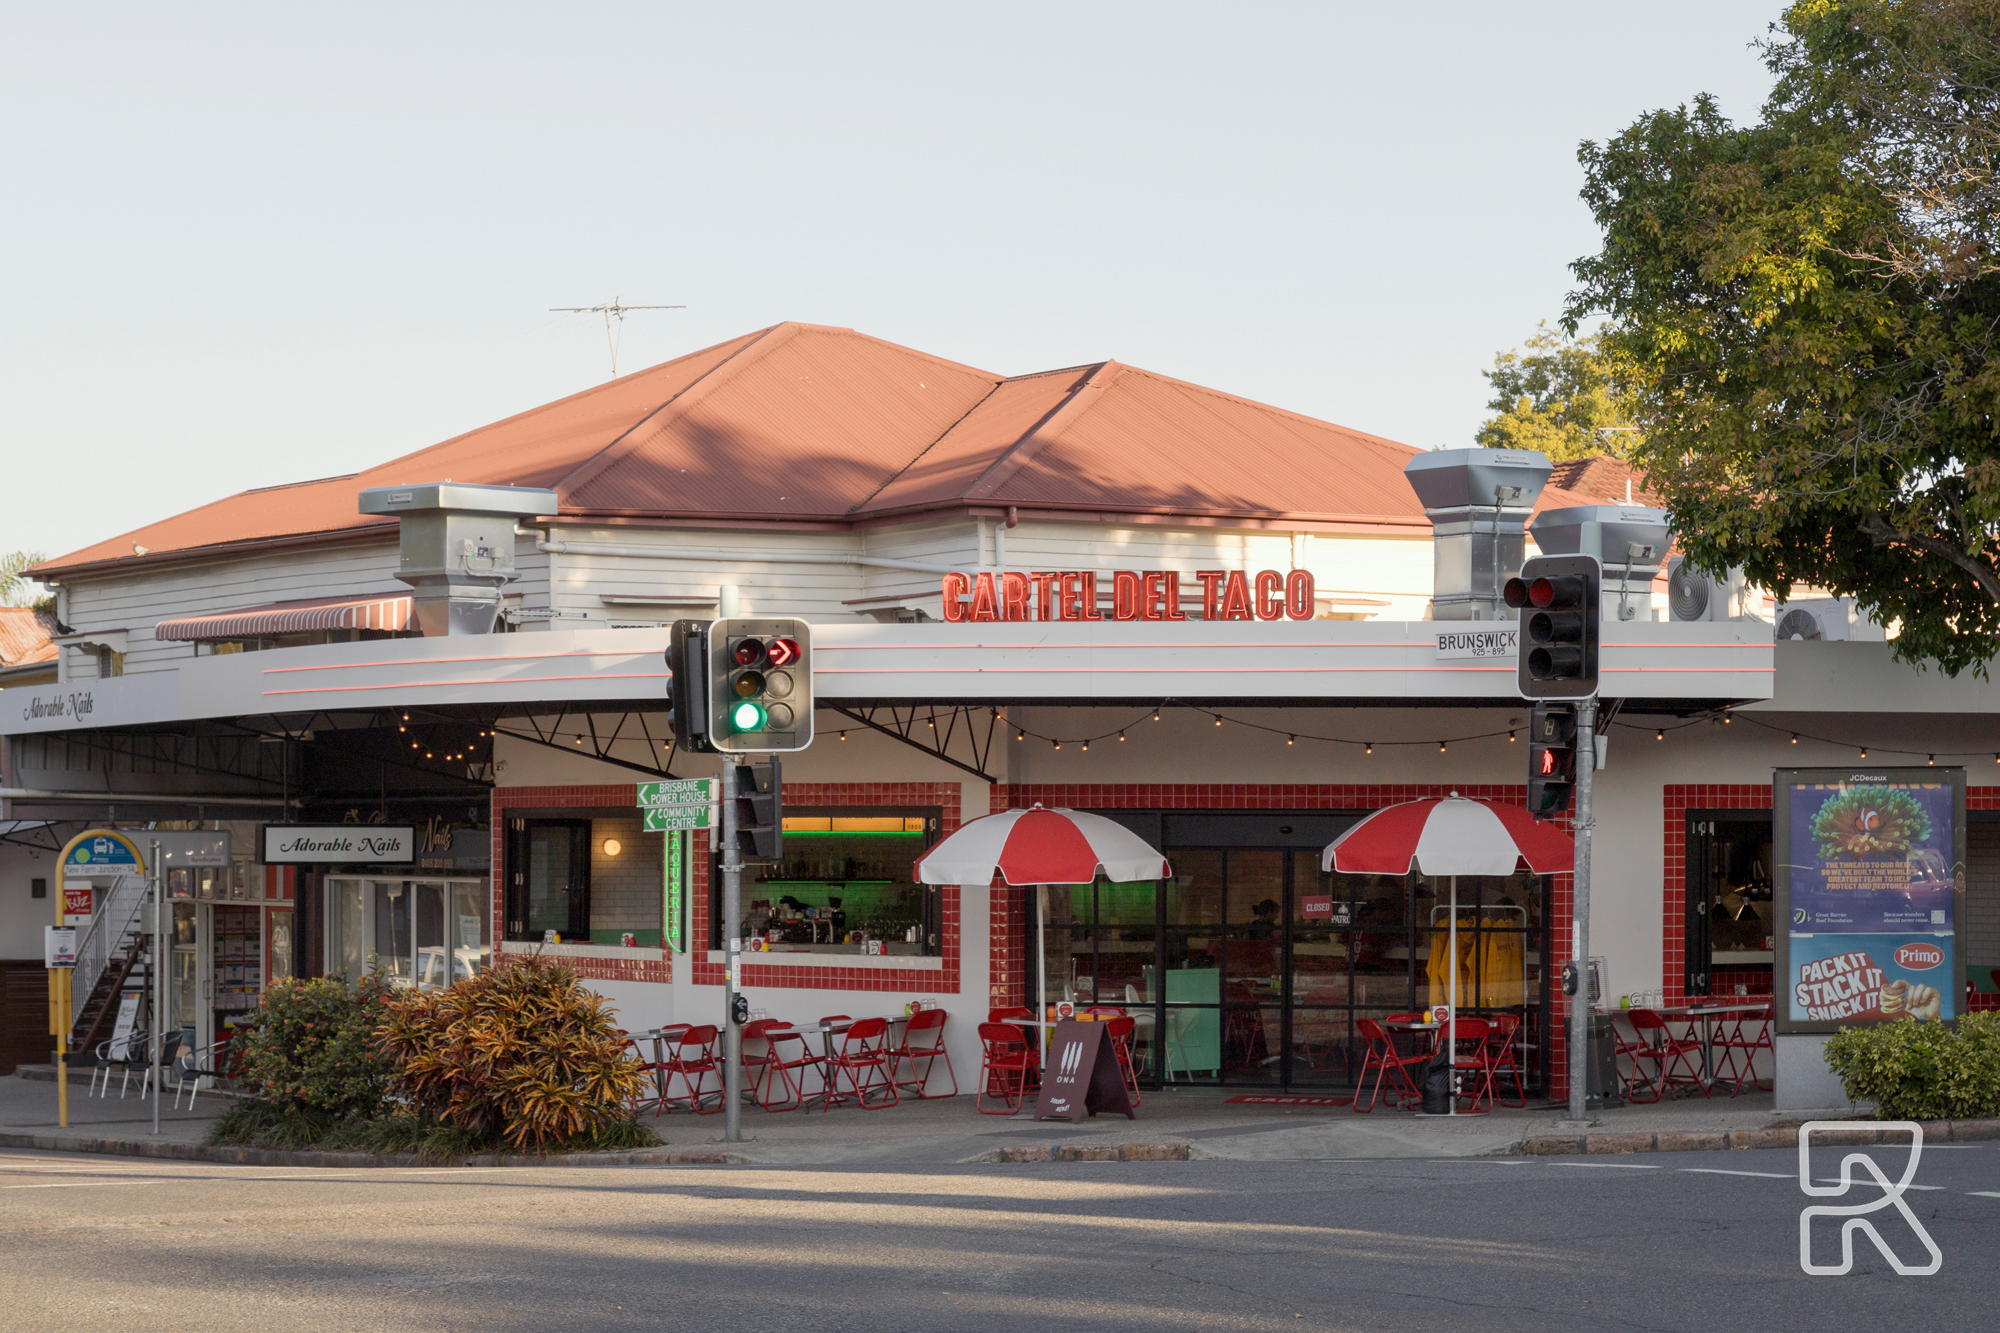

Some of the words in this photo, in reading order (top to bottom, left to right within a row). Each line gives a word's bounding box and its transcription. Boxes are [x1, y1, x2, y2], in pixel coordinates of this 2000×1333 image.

[942, 571, 1101, 622] CARTEL
[1113, 570, 1187, 622] DEL
[1196, 569, 1315, 621] TACO
[1439, 632, 1517, 650] BRUNSWICK
[23, 698, 64, 720] Adorable
[67, 692, 94, 722] Nails
[659, 781, 698, 793] BRISBANE
[1849, 774, 1887, 782] JCDecaux
[651, 793, 677, 804] POWER
[680, 791, 706, 802] HOUSE
[658, 806, 706, 819] COMMUNITY
[666, 817, 697, 829] CENTRE
[421, 815, 453, 853] Nails
[280, 838, 352, 853] Adorable
[358, 838, 400, 856] Nails
[1306, 903, 1330, 912] CLOSED
[1900, 950, 1940, 963] Primo
[1802, 955, 1852, 982] PACK
[1848, 952, 1866, 968] IT
[1797, 970, 1867, 1006] STACK
[1866, 968, 1882, 989] IT
[1808, 996, 1864, 1021] SNACK
[1866, 992, 1878, 1009] IT
